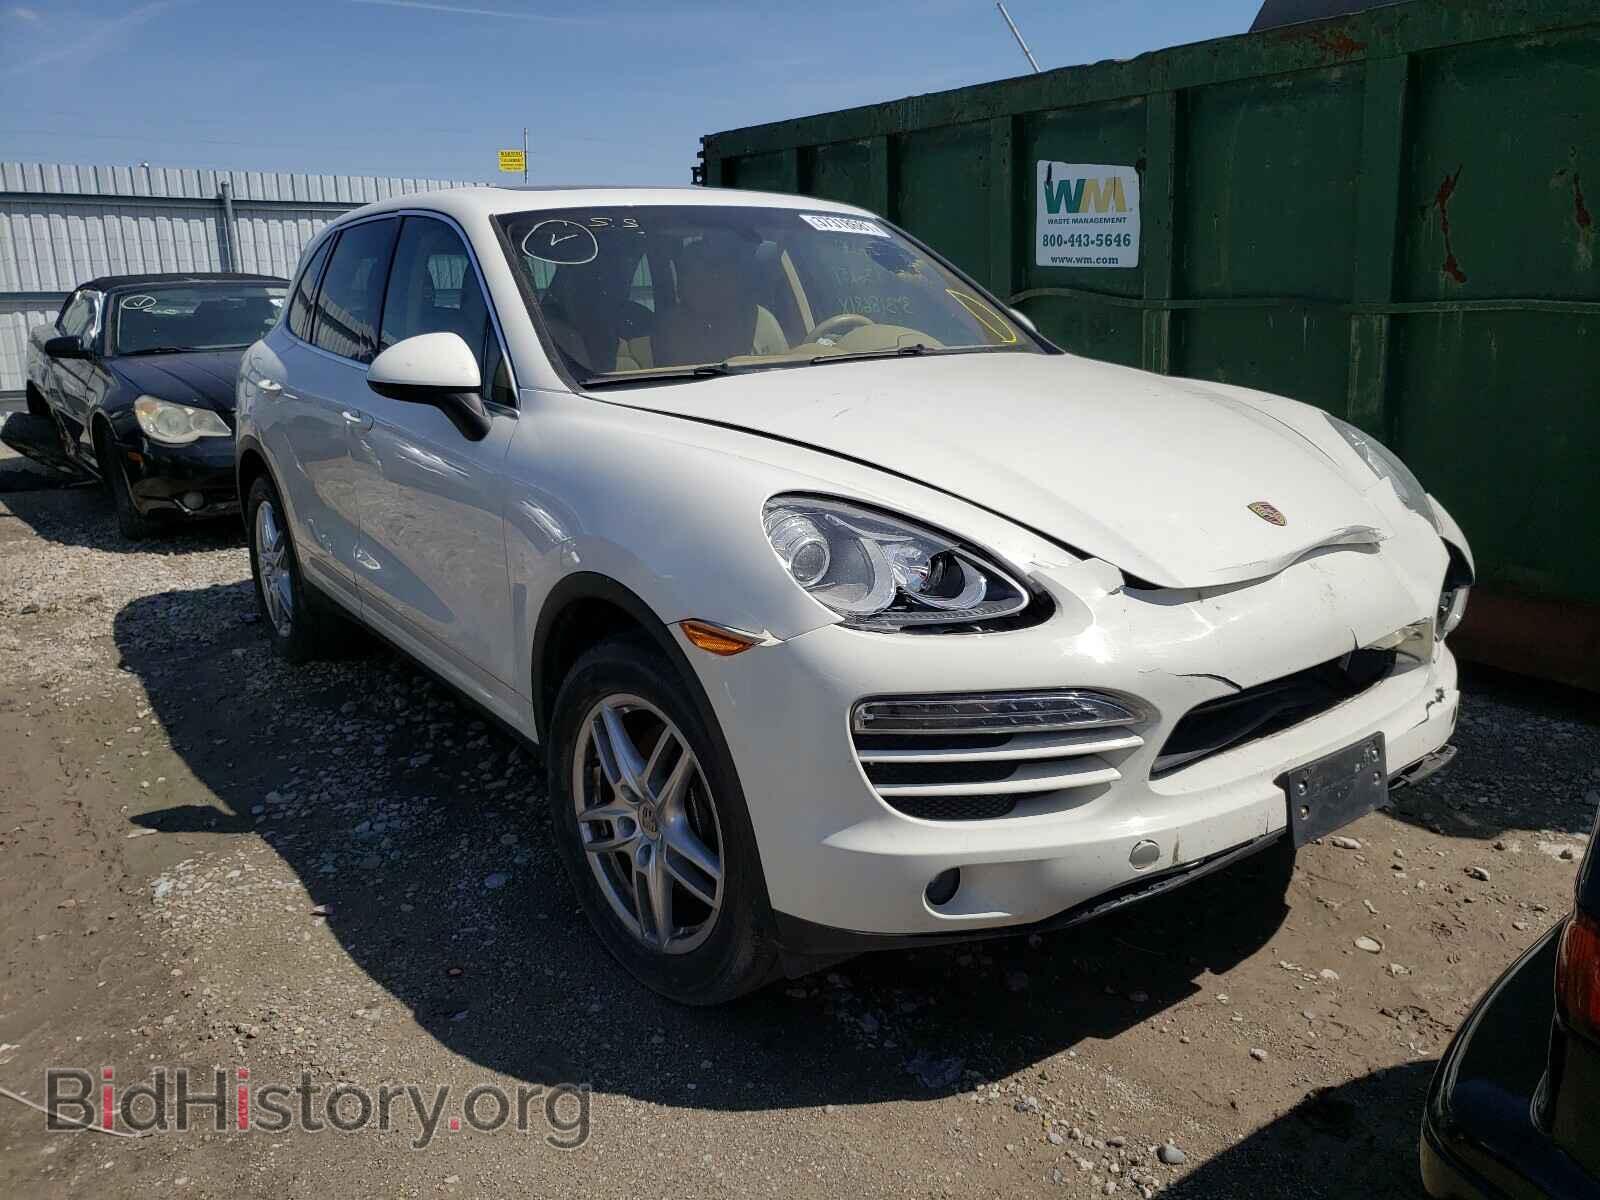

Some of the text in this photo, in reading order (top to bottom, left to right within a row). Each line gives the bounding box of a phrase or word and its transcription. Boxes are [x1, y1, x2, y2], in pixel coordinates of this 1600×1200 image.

[1044, 178, 1127, 214] WM
[1072, 216, 1127, 224] MANAGEMENT
[1042, 232, 1131, 248] 800-443-5646
[1050, 255, 1119, 265] www.wm.com
